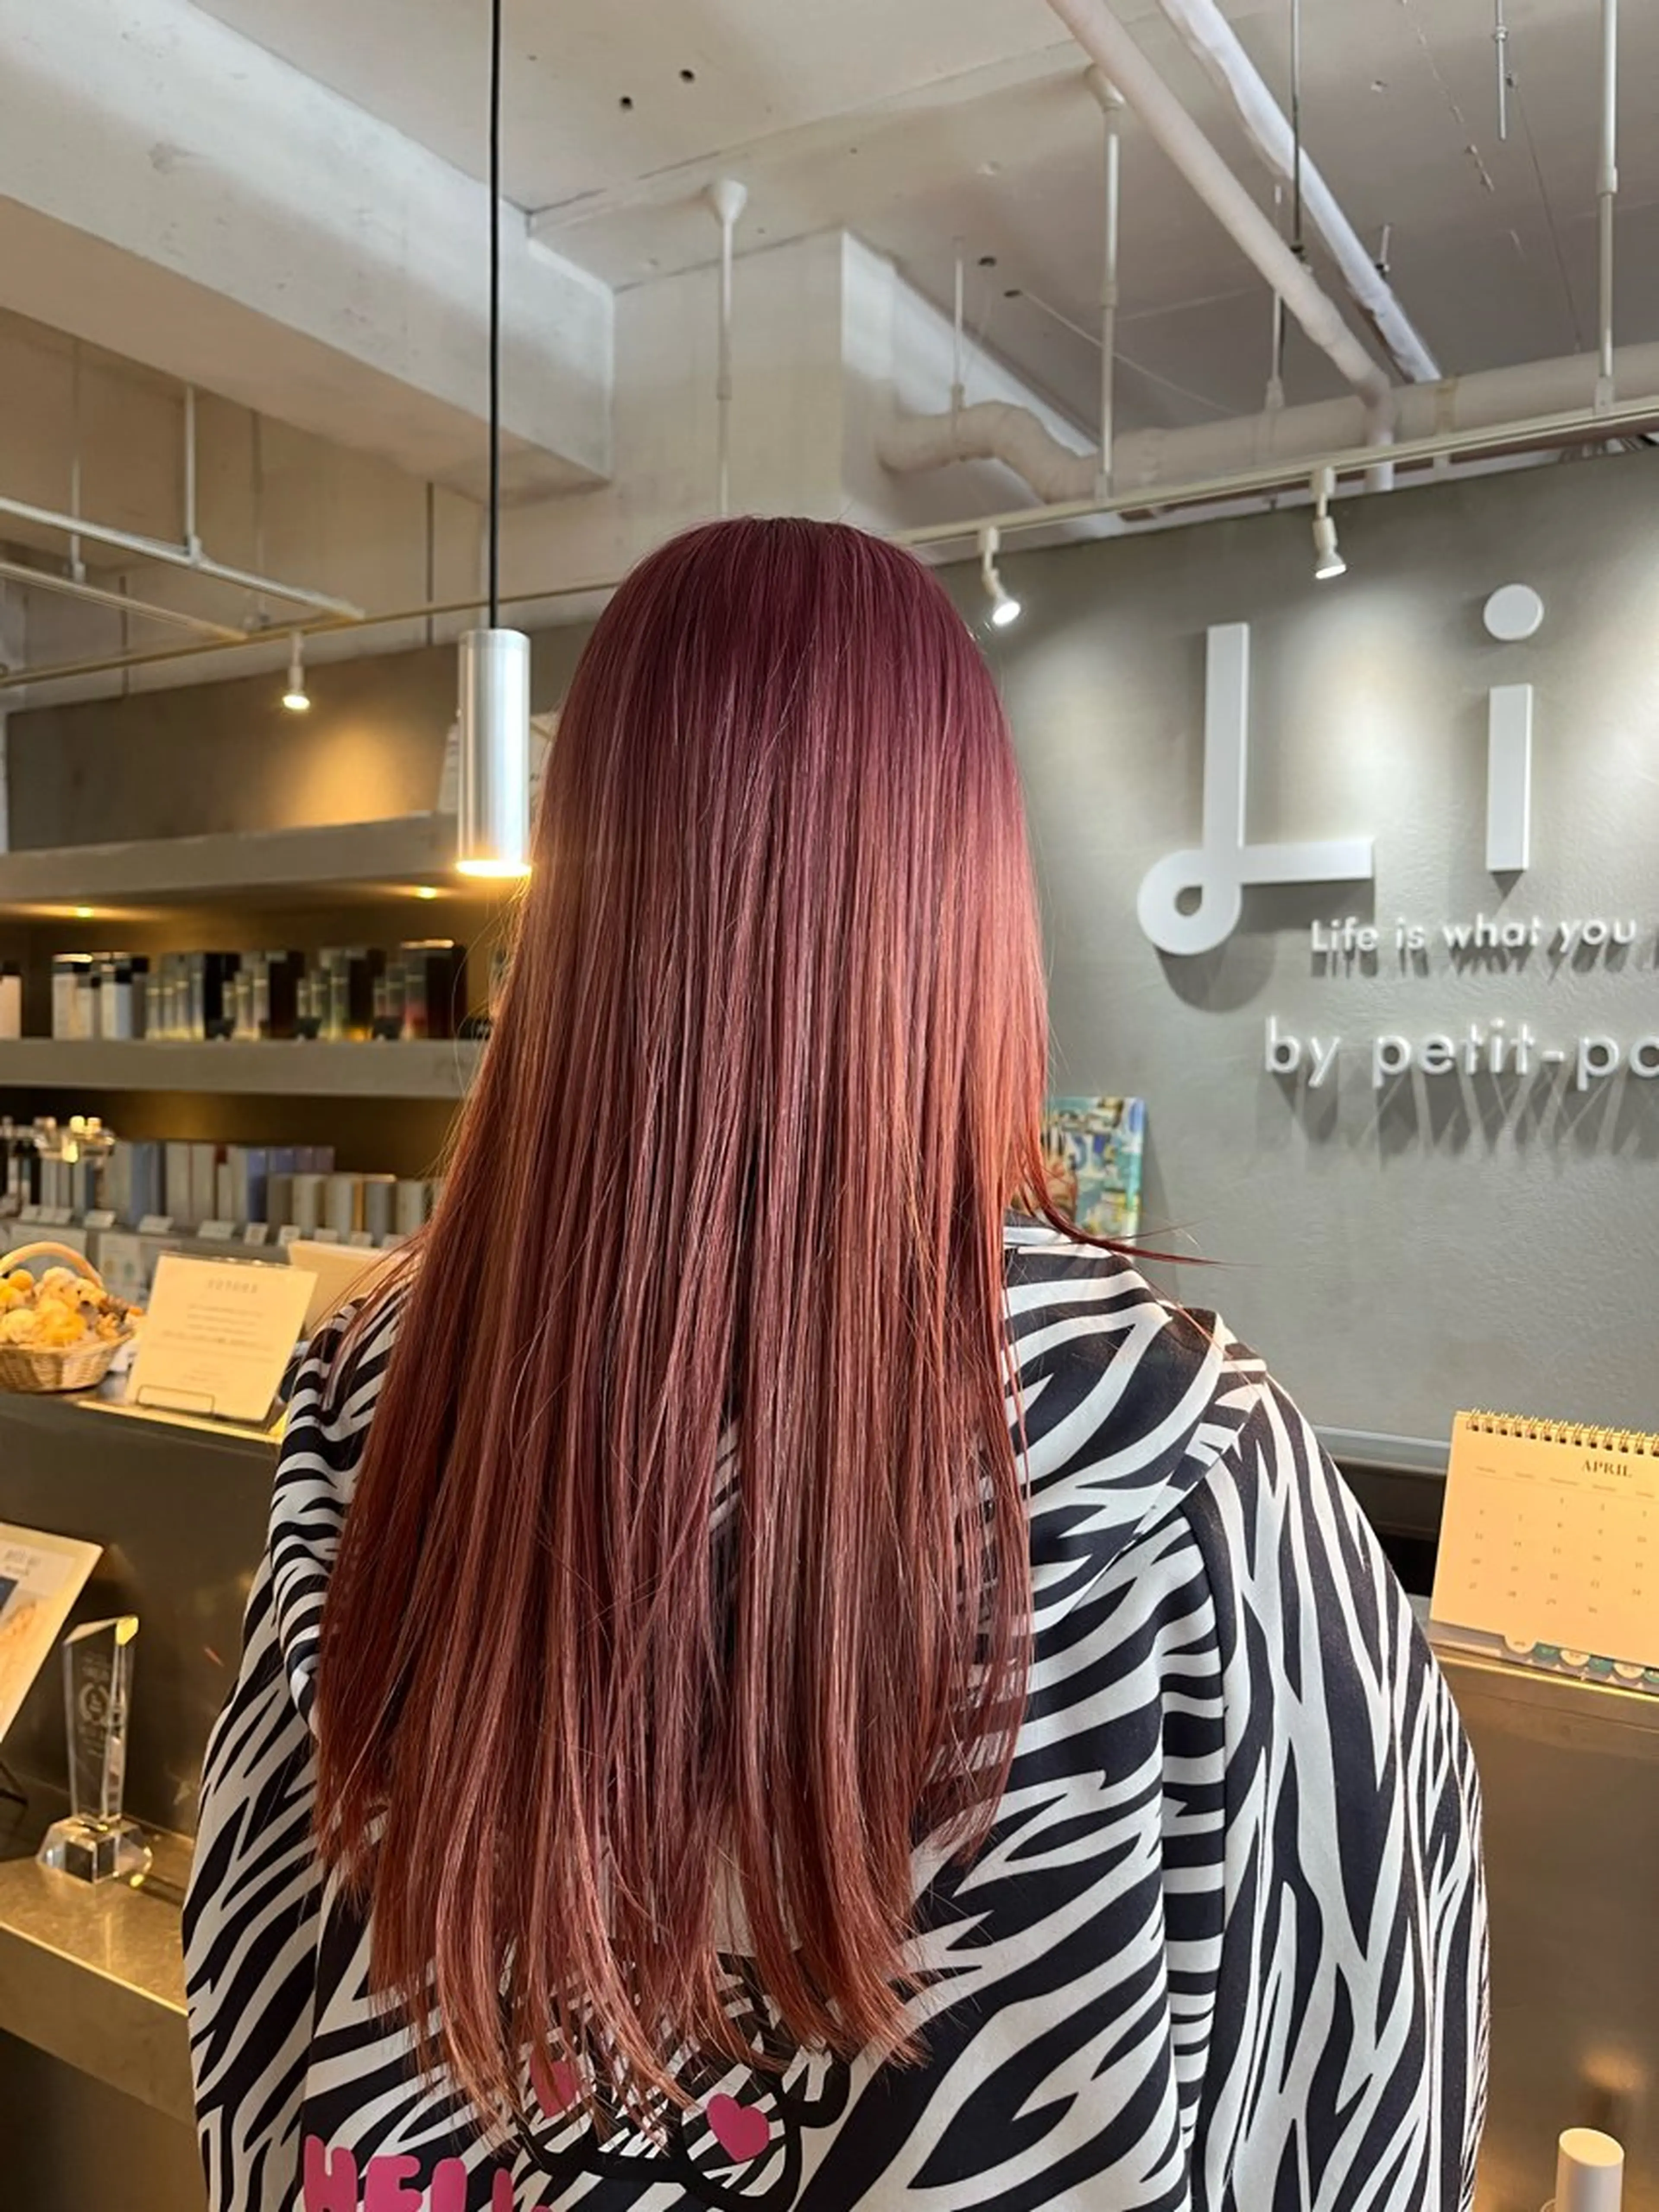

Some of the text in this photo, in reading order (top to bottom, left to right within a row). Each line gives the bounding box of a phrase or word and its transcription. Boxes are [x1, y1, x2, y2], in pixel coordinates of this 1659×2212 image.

[1311, 912, 1637, 953] Life is what you
[1265, 1015, 1341, 1088] by
[1581, 1459, 1633, 1478] APRIL
